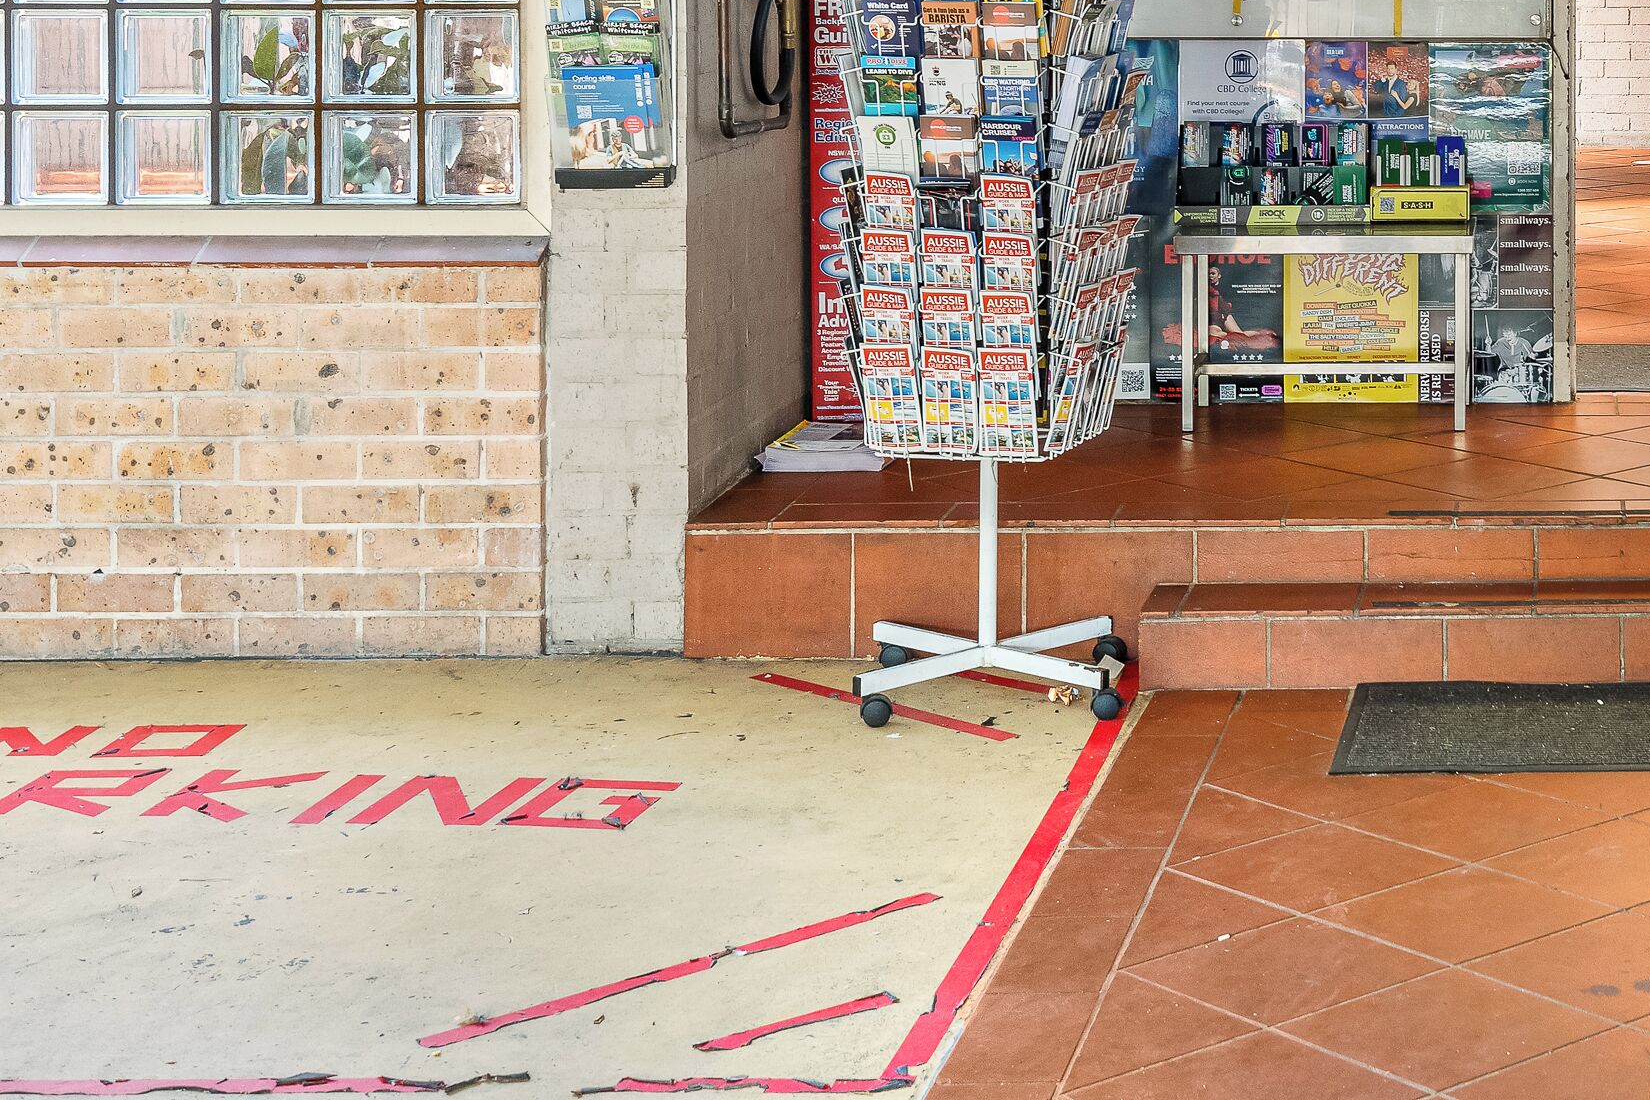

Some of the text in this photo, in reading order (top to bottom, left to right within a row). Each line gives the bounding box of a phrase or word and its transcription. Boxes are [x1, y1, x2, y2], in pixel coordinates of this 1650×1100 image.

[929, 14, 966, 23] BARISTA
[1217, 84, 1267, 94] CBD College
[981, 122, 1021, 130] HARBOUR
[1376, 123, 1424, 131] ATTRACTIONS
[870, 178, 907, 189] AUSSIE
[987, 182, 1027, 193] AUSSIE
[1500, 216, 1551, 225] smallways.
[867, 236, 905, 246] AUSSIE
[927, 238, 965, 248] AUSSIE
[988, 240, 1027, 250] AUSSIE
[1500, 240, 1551, 249] smallways.
[1500, 263, 1551, 273] smallways.
[1500, 287, 1551, 297] smallways.
[866, 292, 904, 303] AUSSIE
[926, 295, 964, 306] AUSSIE
[987, 299, 1026, 309] AUSSIE
[1420, 311, 1430, 362] REMORSE
[868, 351, 906, 361] AUSSIE
[928, 355, 967, 366] AUSSIE
[984, 355, 1024, 365] AUSSIE
